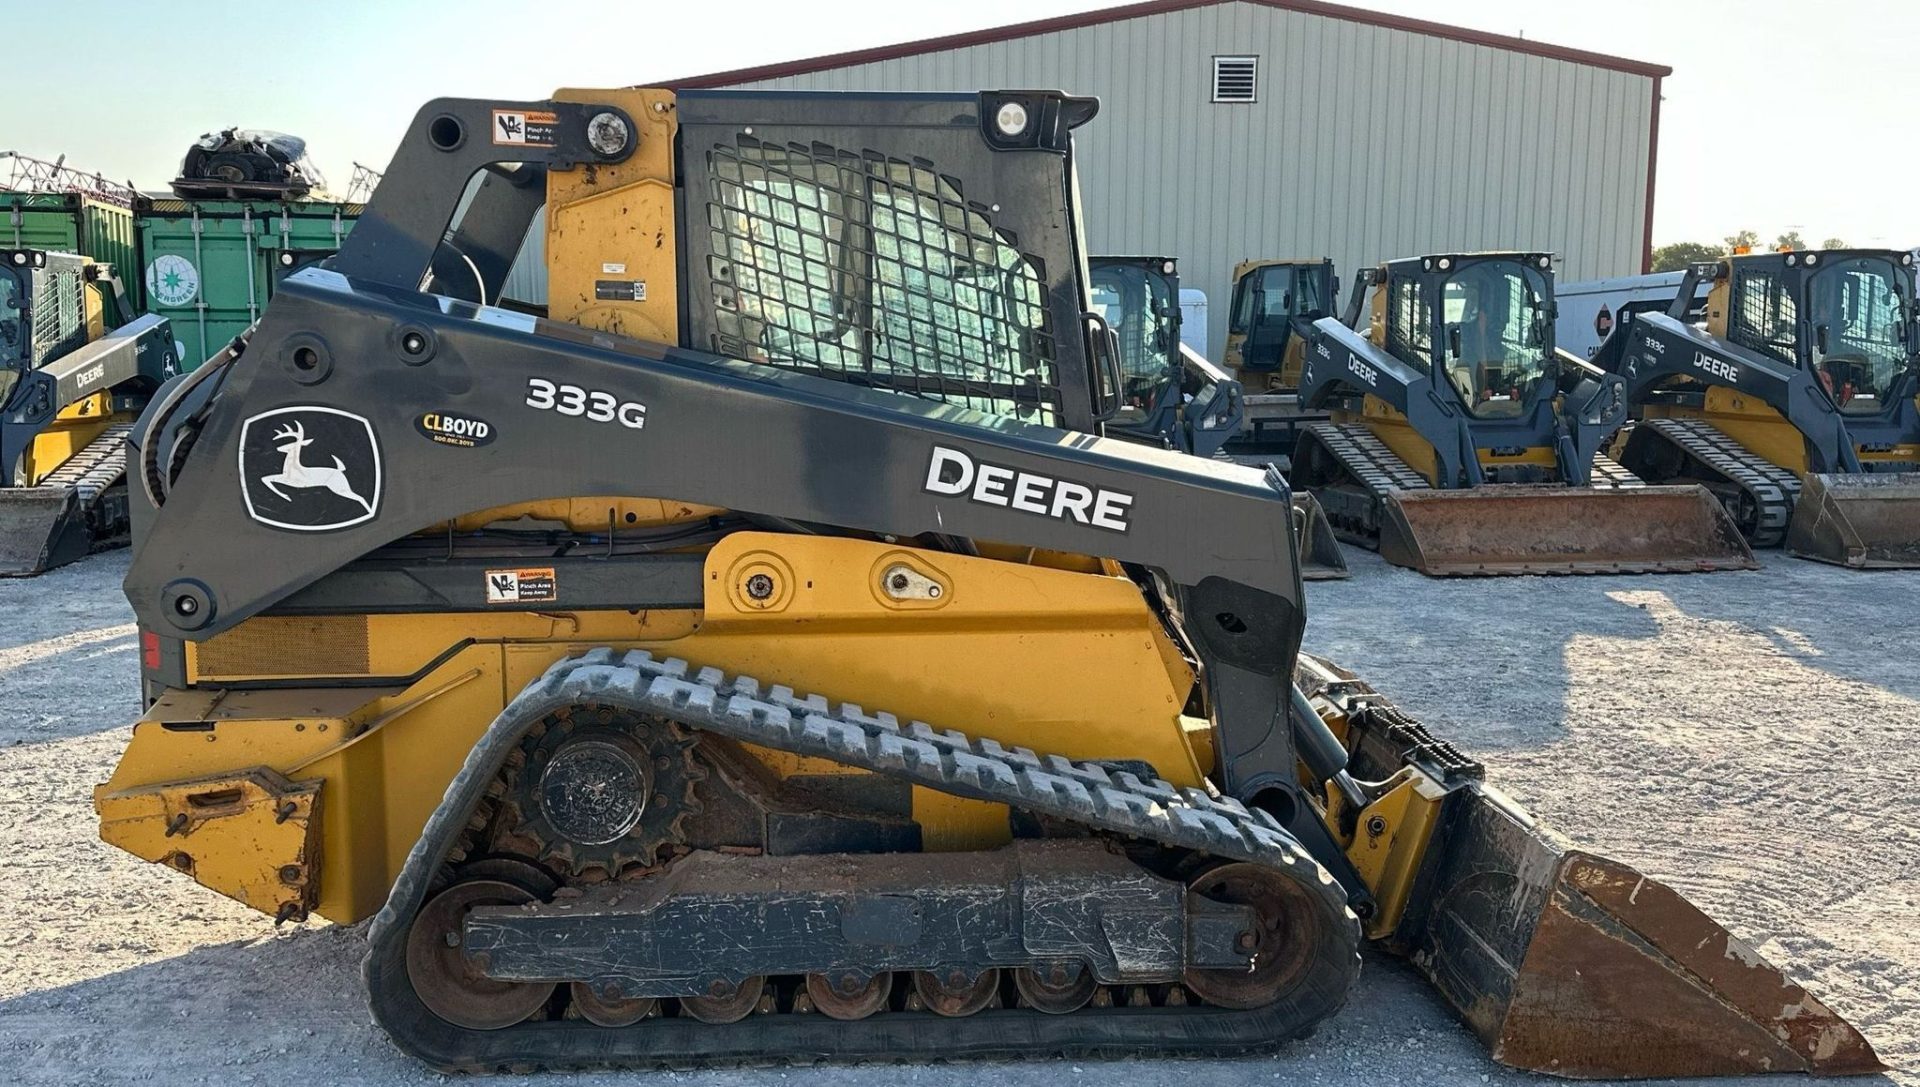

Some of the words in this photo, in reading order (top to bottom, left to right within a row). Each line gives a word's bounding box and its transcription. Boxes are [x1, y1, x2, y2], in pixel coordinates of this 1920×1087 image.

[1645, 336, 1665, 354] 333G
[76, 363, 105, 389] DEERE
[1348, 352, 1378, 387] DEERE
[1693, 351, 1739, 383] DEERE
[526, 378, 647, 429] 333G
[925, 446, 1133, 532] DEERE
